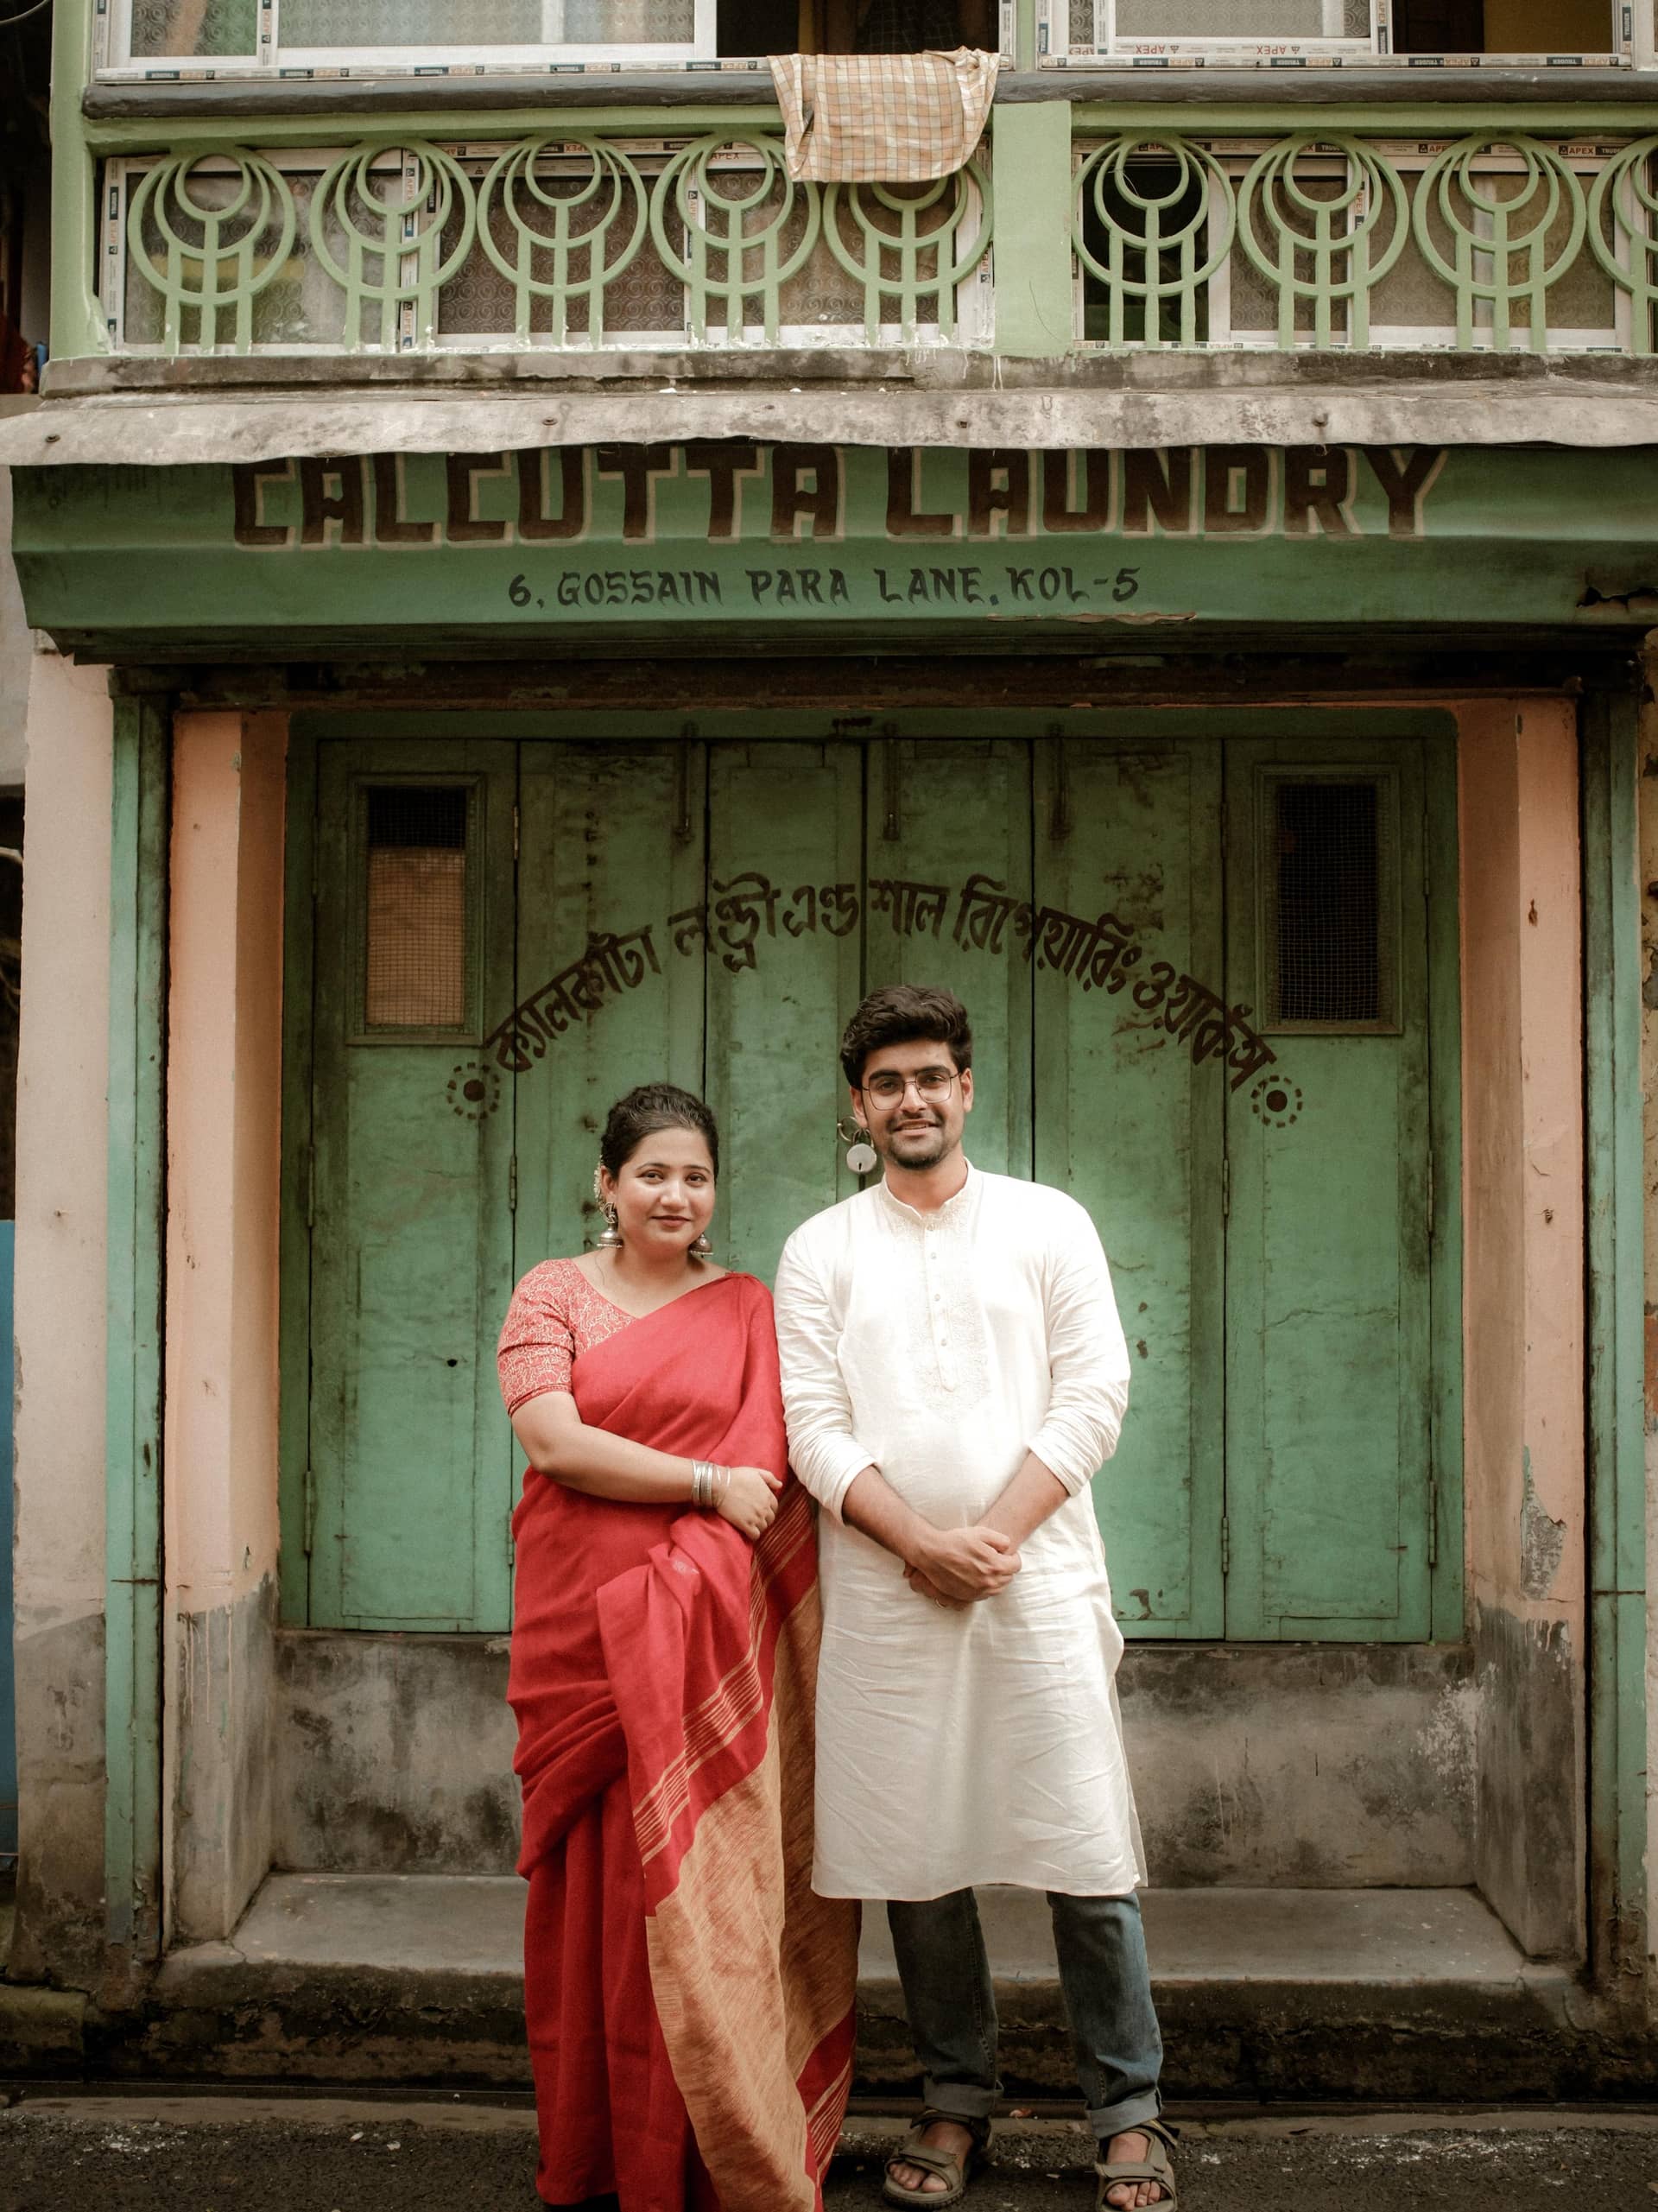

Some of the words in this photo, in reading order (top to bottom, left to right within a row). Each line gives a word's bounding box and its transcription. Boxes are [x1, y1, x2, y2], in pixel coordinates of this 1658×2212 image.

[1136, 45, 1166, 54] APEX
[1256, 46, 1287, 54] APEX
[233, 442, 845, 552] CALCUTTA
[885, 443, 1448, 544] LAUNDRY
[557, 569, 723, 607] GOSSAIN
[745, 567, 849, 606] PARA
[869, 879, 949, 938] শাল
